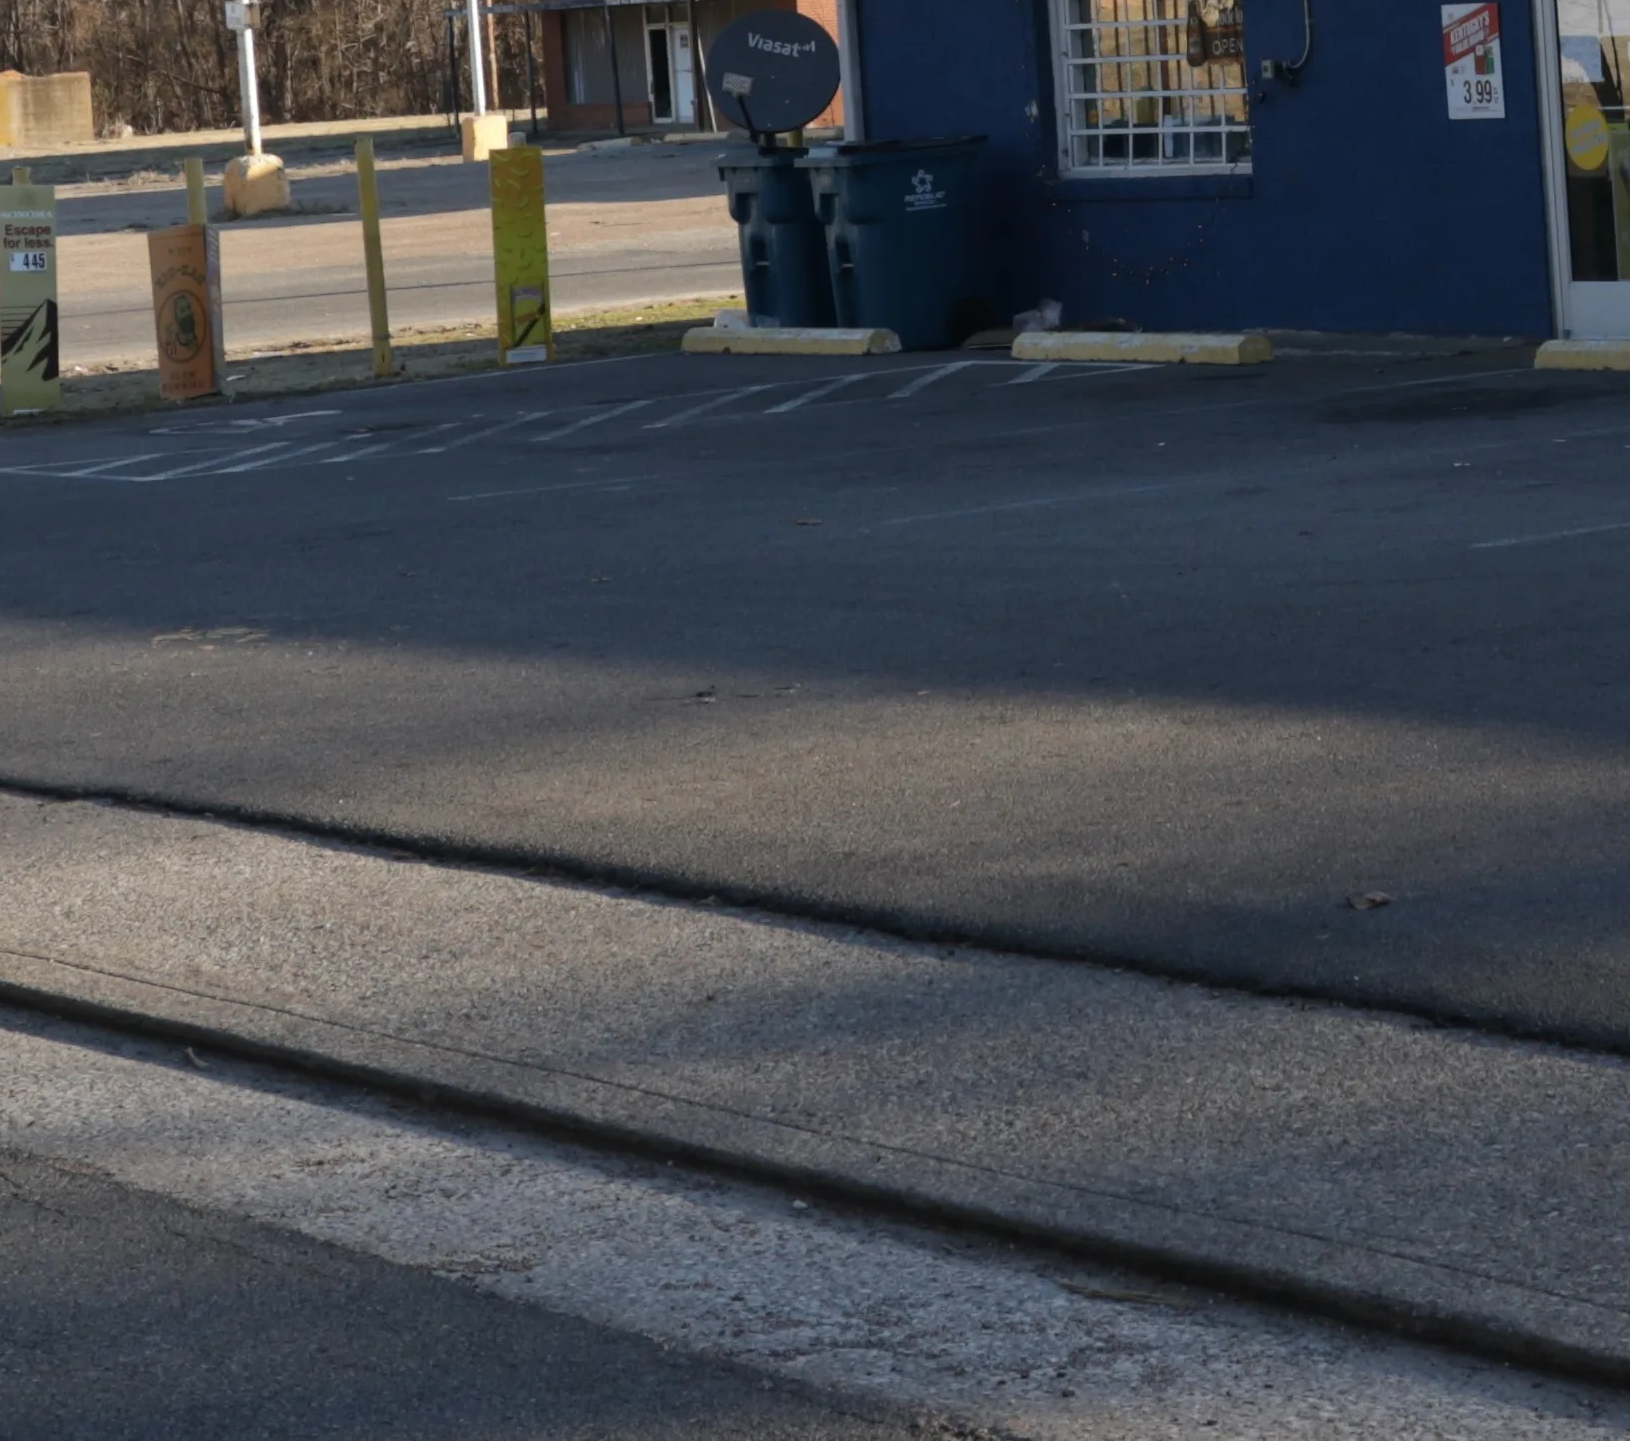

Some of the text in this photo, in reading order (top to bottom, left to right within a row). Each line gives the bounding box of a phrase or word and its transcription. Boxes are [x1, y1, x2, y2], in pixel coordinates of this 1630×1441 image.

[747, 32, 800, 58] Viasat
[1463, 79, 1493, 105] 3.99
[4, 224, 52, 238] Escape
[2, 237, 21, 249] for
